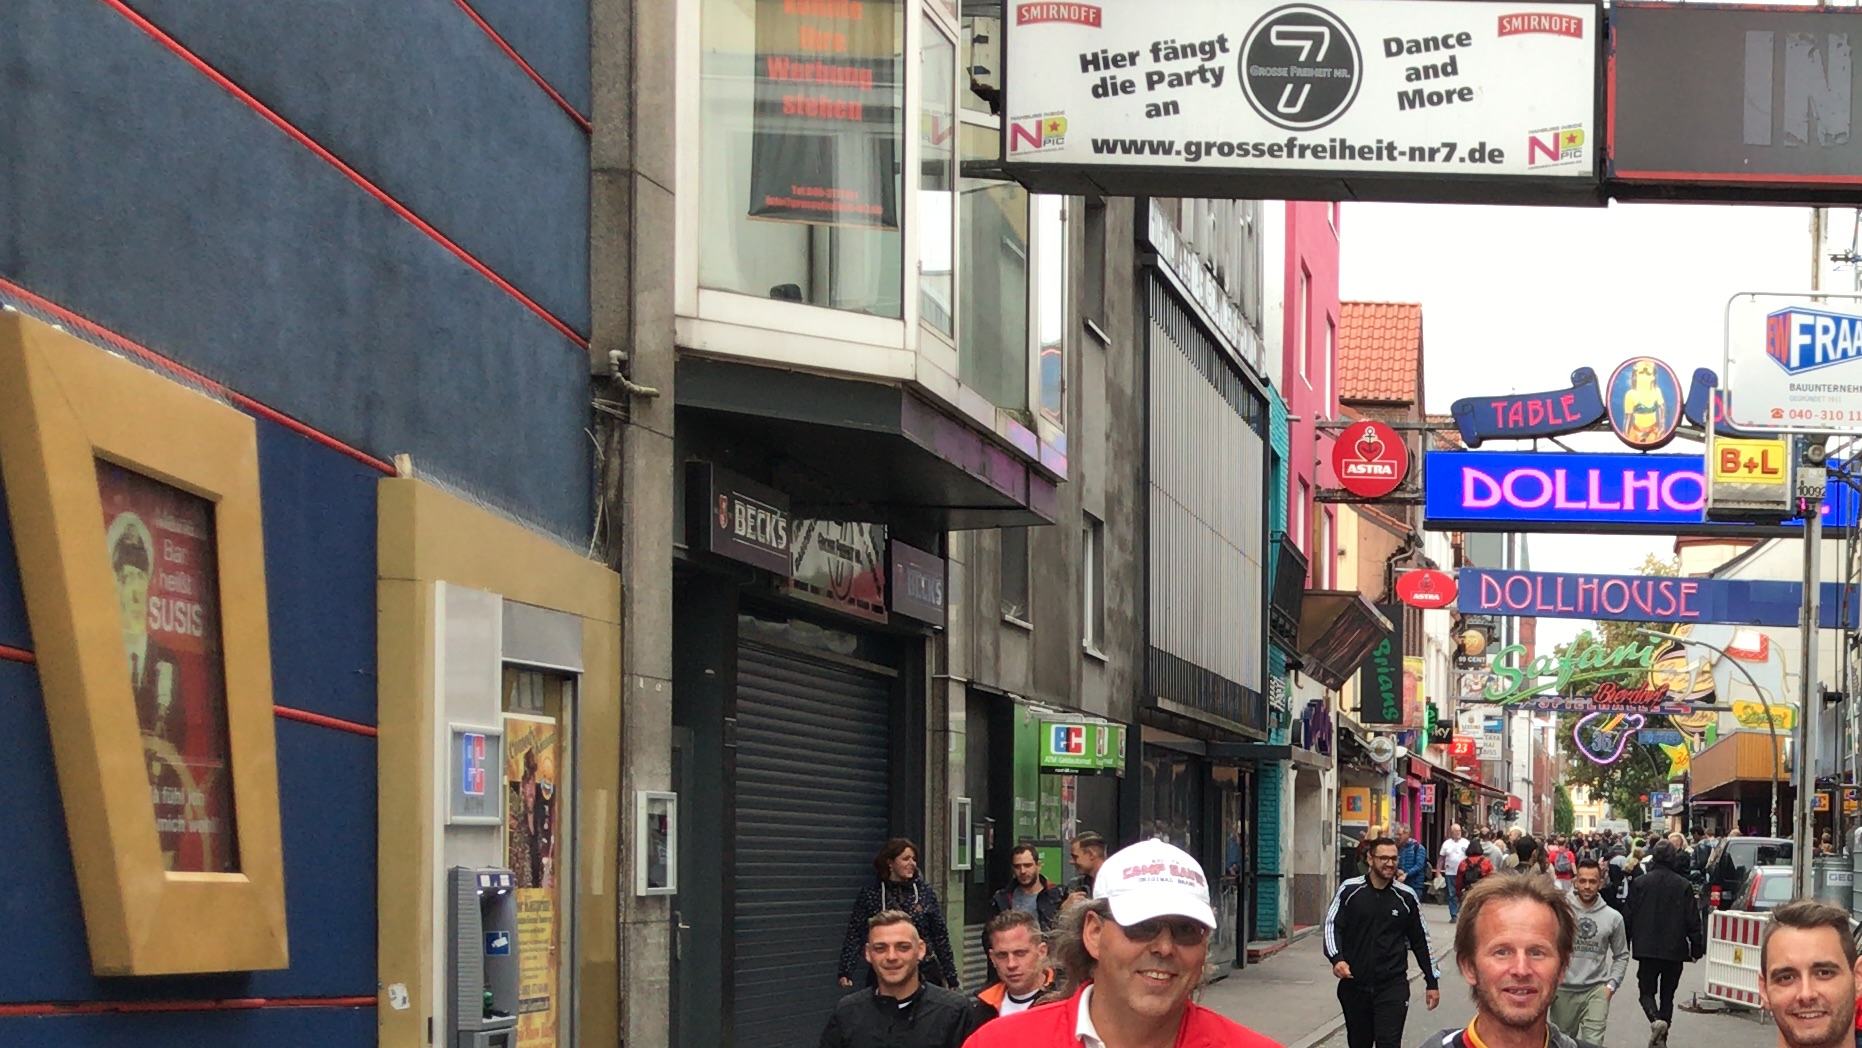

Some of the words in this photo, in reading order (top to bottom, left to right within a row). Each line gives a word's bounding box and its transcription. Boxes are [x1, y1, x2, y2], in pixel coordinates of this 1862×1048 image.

[1021, 5, 1097, 23] SMIRNOFF
[1502, 16, 1578, 33] SMIRNOFF
[1079, 49, 1140, 73] Hier
[1149, 33, 1230, 63] fängt
[1383, 31, 1472, 58] Dance
[767, 56, 873, 90] Werbung
[1091, 75, 1135, 99] die
[1145, 64, 1225, 91] Party
[1405, 55, 1459, 82] and
[1397, 85, 1474, 111] More
[1743, 29, 1853, 148] IN
[1145, 99, 1180, 119] an
[1091, 137, 1505, 164] www.grossefreiheit-nr7.de
[1490, 395, 1581, 429] TABLE
[1347, 464, 1392, 475] ASTRA
[1721, 448, 1779, 474] B+L
[1461, 466, 1706, 513] DOLLHO
[1412, 593, 1440, 601] ASTRA
[1480, 573, 1700, 617] DOLLHOUSE
[148, 596, 203, 637] SUSIS
[1484, 630, 1663, 701] Safari
[1372, 638, 1399, 721] Brians
[1592, 682, 1669, 707] Bierdorf
[1455, 743, 1468, 753] 23
